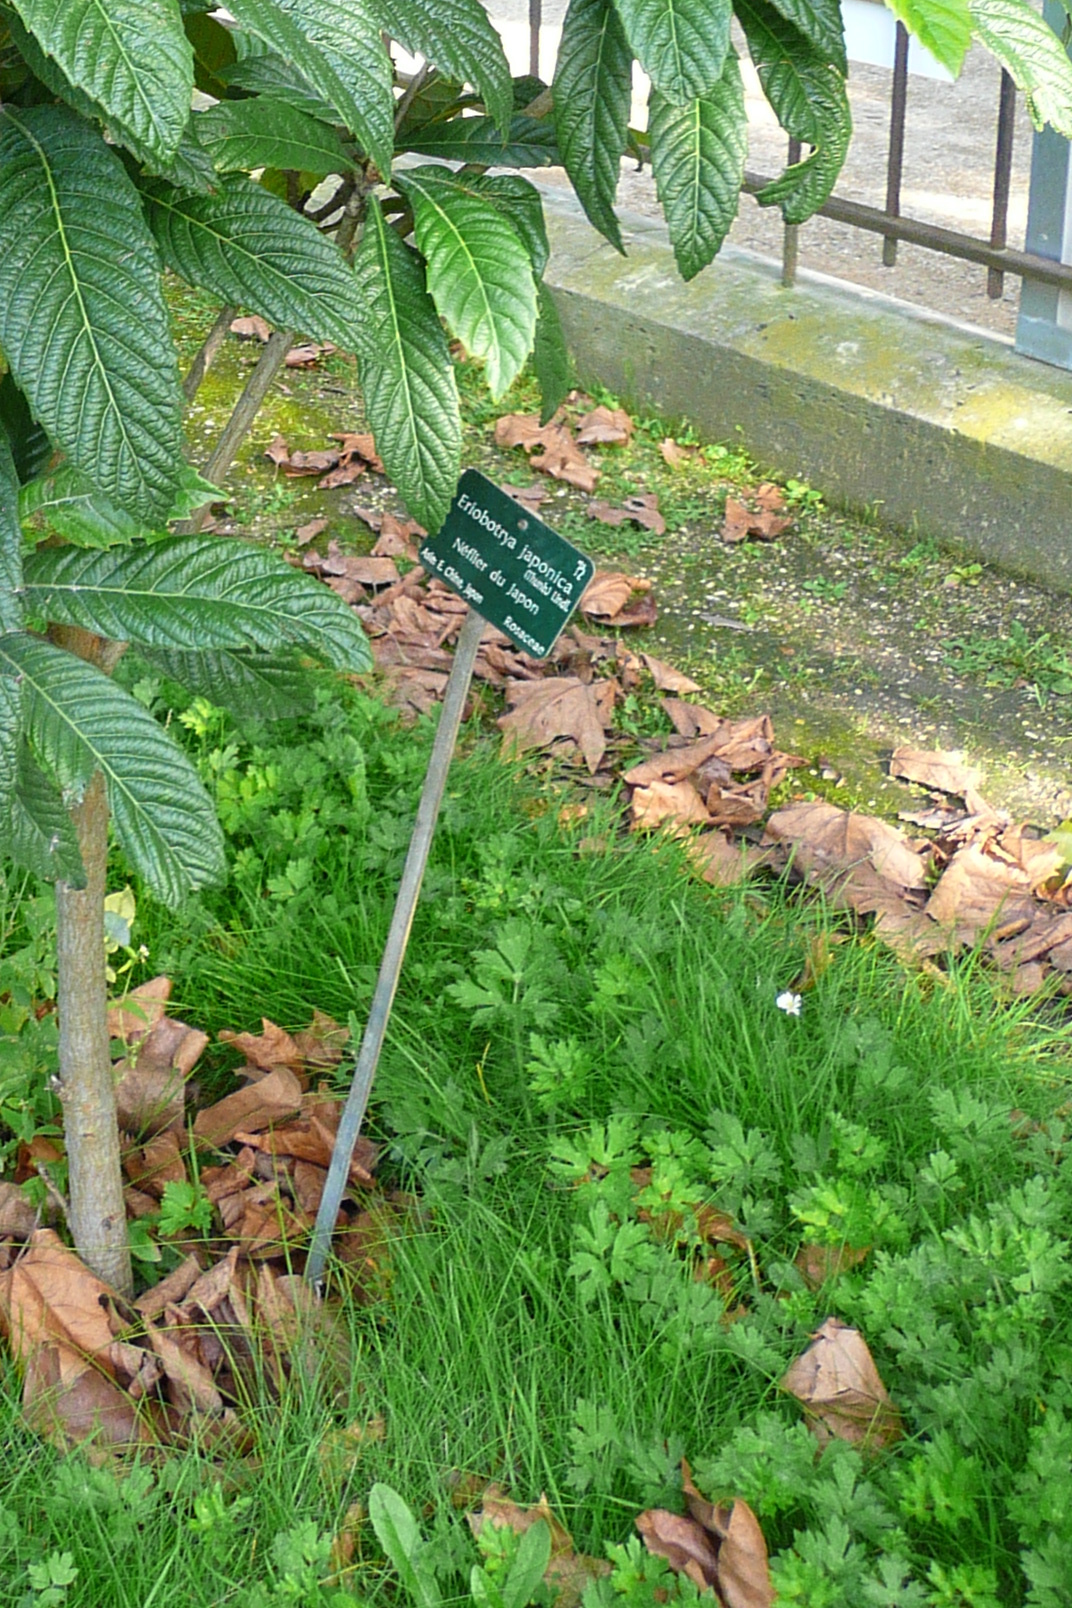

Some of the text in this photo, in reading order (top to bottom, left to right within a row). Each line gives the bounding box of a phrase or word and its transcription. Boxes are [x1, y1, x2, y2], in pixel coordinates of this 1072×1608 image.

[452, 538, 488, 571] Néflier
[489, 567, 506, 586] du
[457, 494, 573, 595] Eriobotrya japonica
[503, 616, 545, 655] Rosaceae
